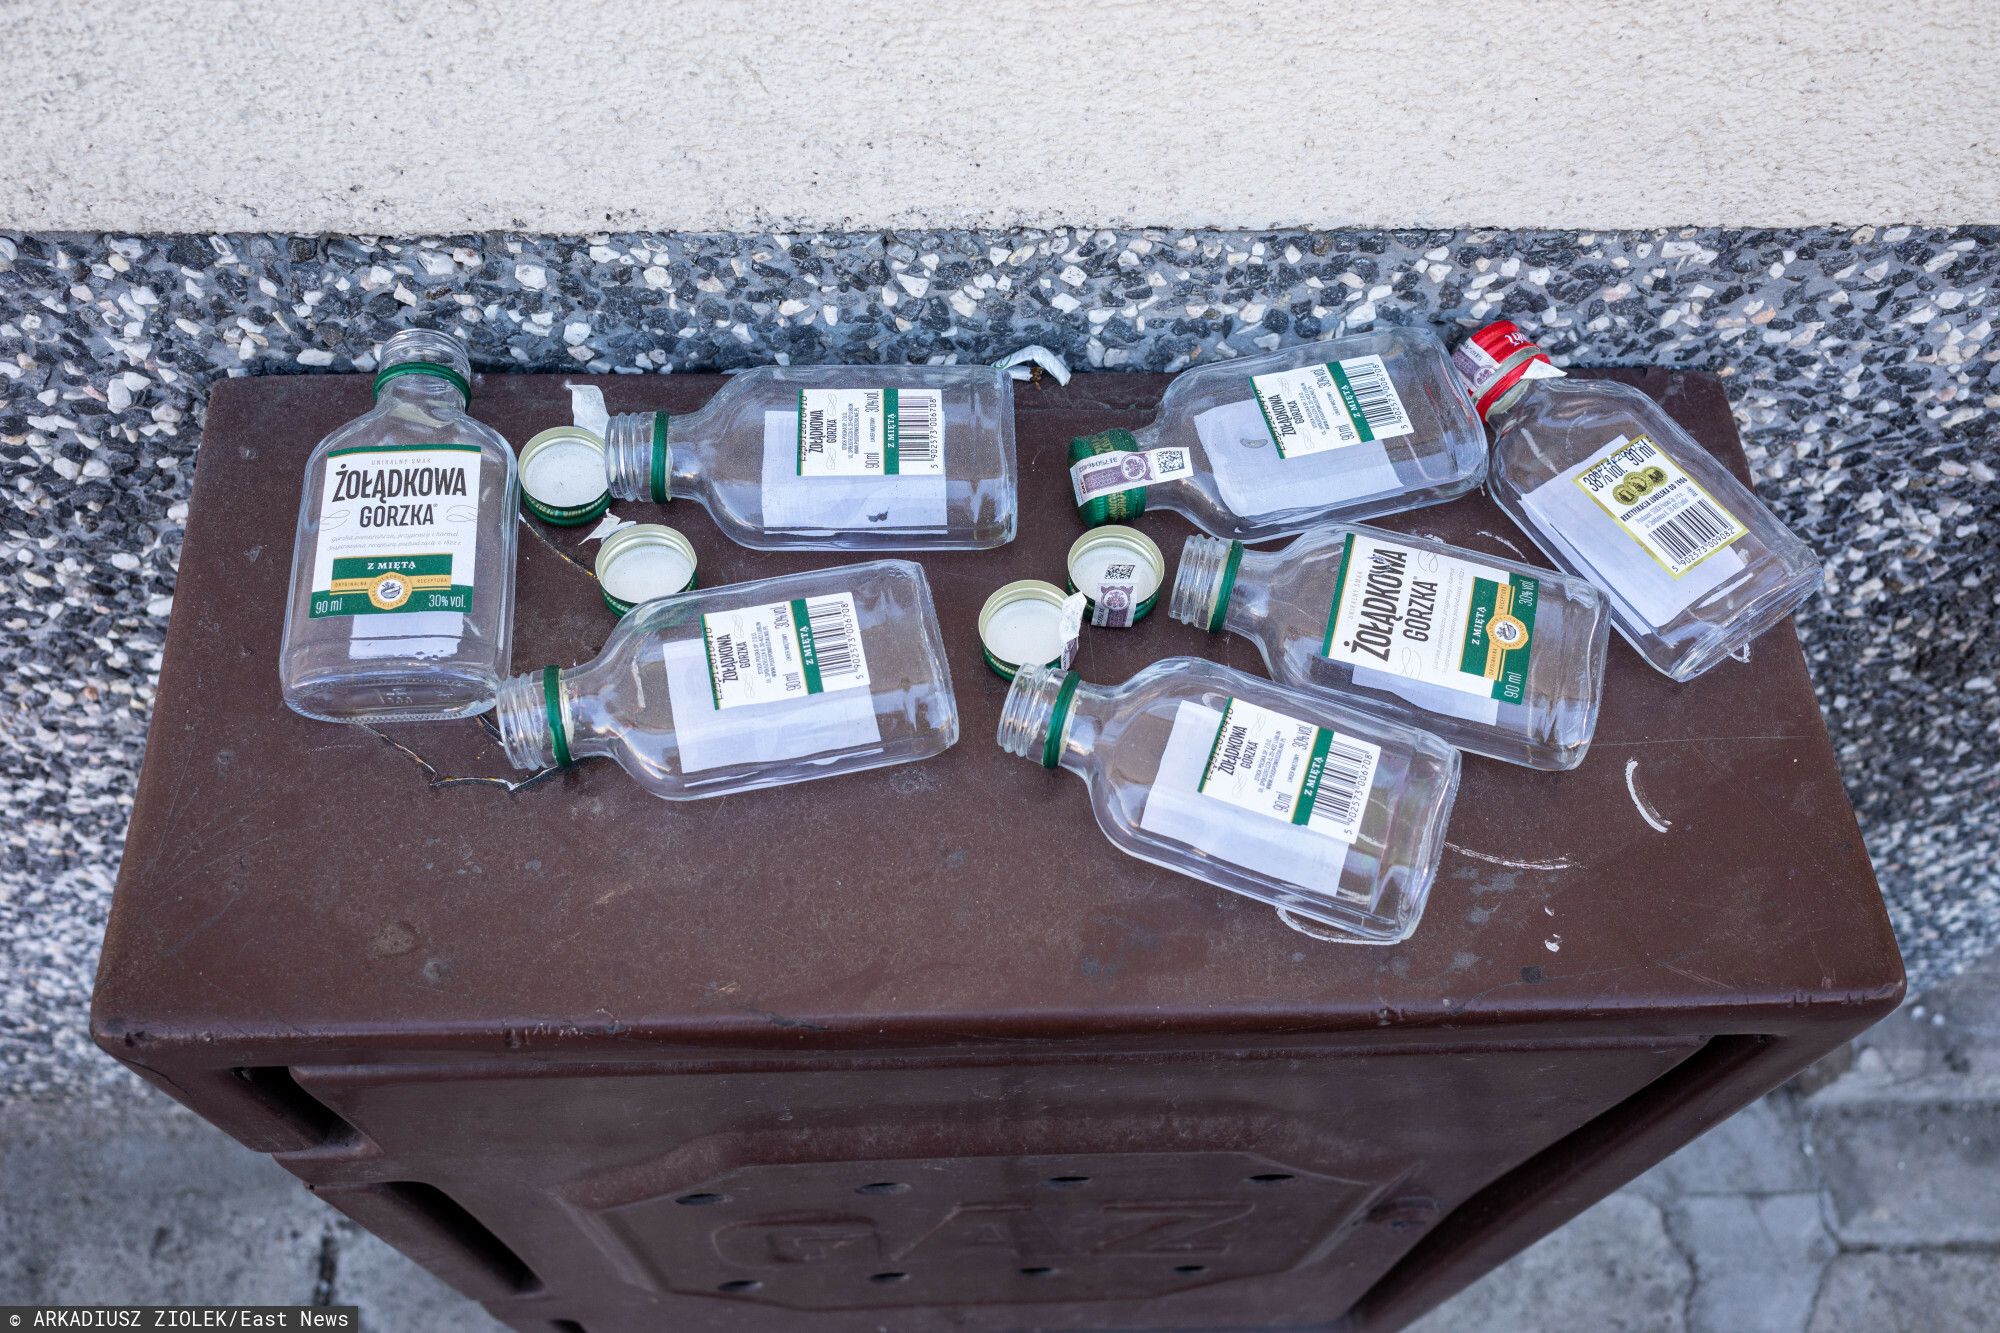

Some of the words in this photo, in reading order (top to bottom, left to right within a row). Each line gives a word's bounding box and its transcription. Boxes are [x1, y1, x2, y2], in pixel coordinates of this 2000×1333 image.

[1342, 385, 1357, 411] MIĘTĄ
[865, 400, 880, 412] 30%
[929, 398, 937, 427] 006708
[1387, 394, 1403, 423] 902573
[888, 413, 896, 441] MIĘTĄ
[1336, 425, 1351, 434] ml
[866, 459, 880, 468] 90
[332, 463, 467, 503] ŻOŁĄDKOWA
[1650, 487, 1671, 506] LUBELSKA
[1680, 545, 1708, 566] 902573
[1708, 528, 1735, 549] 009082
[368, 562, 374, 570] Z
[378, 561, 416, 570] MIĘTĄ
[315, 601, 328, 614] 90
[330, 597, 343, 612] ml
[428, 594, 448, 607] 30%
[451, 594, 466, 608] vol.
[1343, 548, 1408, 663] ŻOŁĄDKOWA
[1519, 591, 1533, 606] 30%
[774, 616, 789, 629] 30%
[841, 603, 854, 634] 006708
[1473, 606, 1487, 635] MIĘTĄ
[800, 626, 813, 656] MIĘTĄ
[1472, 637, 1480, 645] Z
[848, 637, 862, 672] 902573
[784, 671, 801, 680] ml
[1507, 672, 1522, 685] ml
[786, 680, 801, 692] 90
[1504, 686, 1518, 699] 90
[1292, 737, 1308, 750] 30%
[1306, 756, 1323, 788] MIĘTĄ
[1303, 788, 1313, 797] Z
[1347, 790, 1363, 823] 902573
[1357, 754, 1373, 787] 006708
[1276, 792, 1292, 802] ml
[1273, 800, 1289, 813] 90
